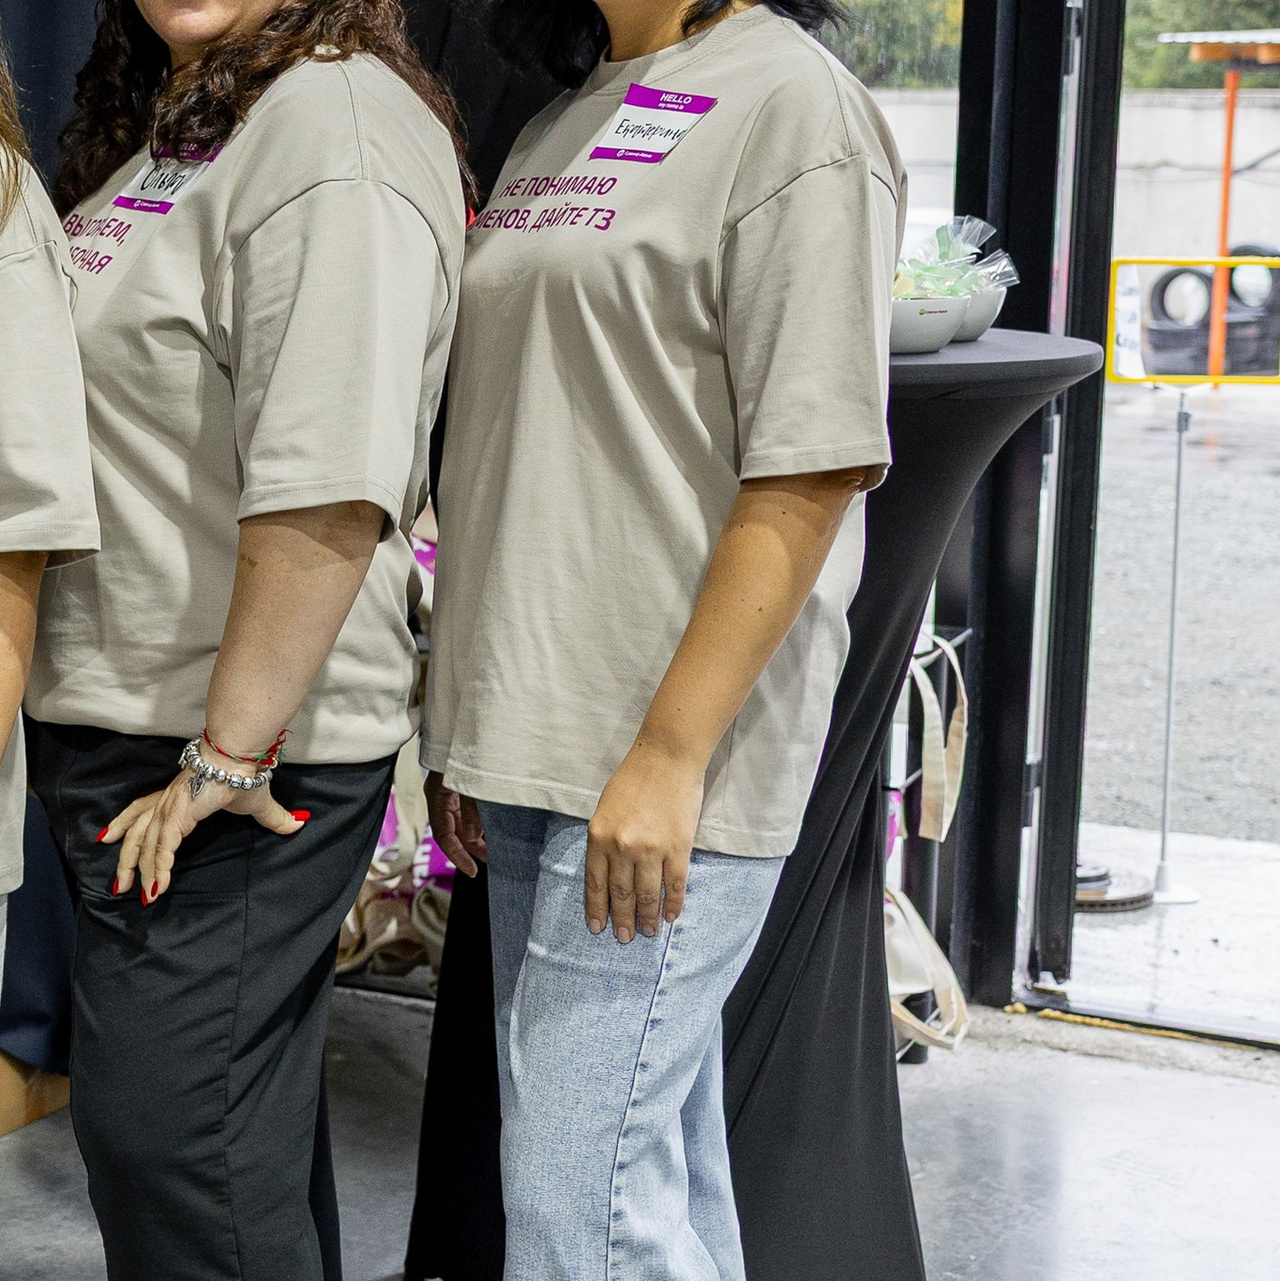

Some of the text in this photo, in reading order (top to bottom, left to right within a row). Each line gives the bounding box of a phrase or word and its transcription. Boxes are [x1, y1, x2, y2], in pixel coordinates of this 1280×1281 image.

[660, 93, 692, 104] HELLO
[499, 176, 618, 198] НЕ ПОНИМАЮ
[474, 202, 616, 233] МЕКОВ, ДАЙТЕ ТЗ
